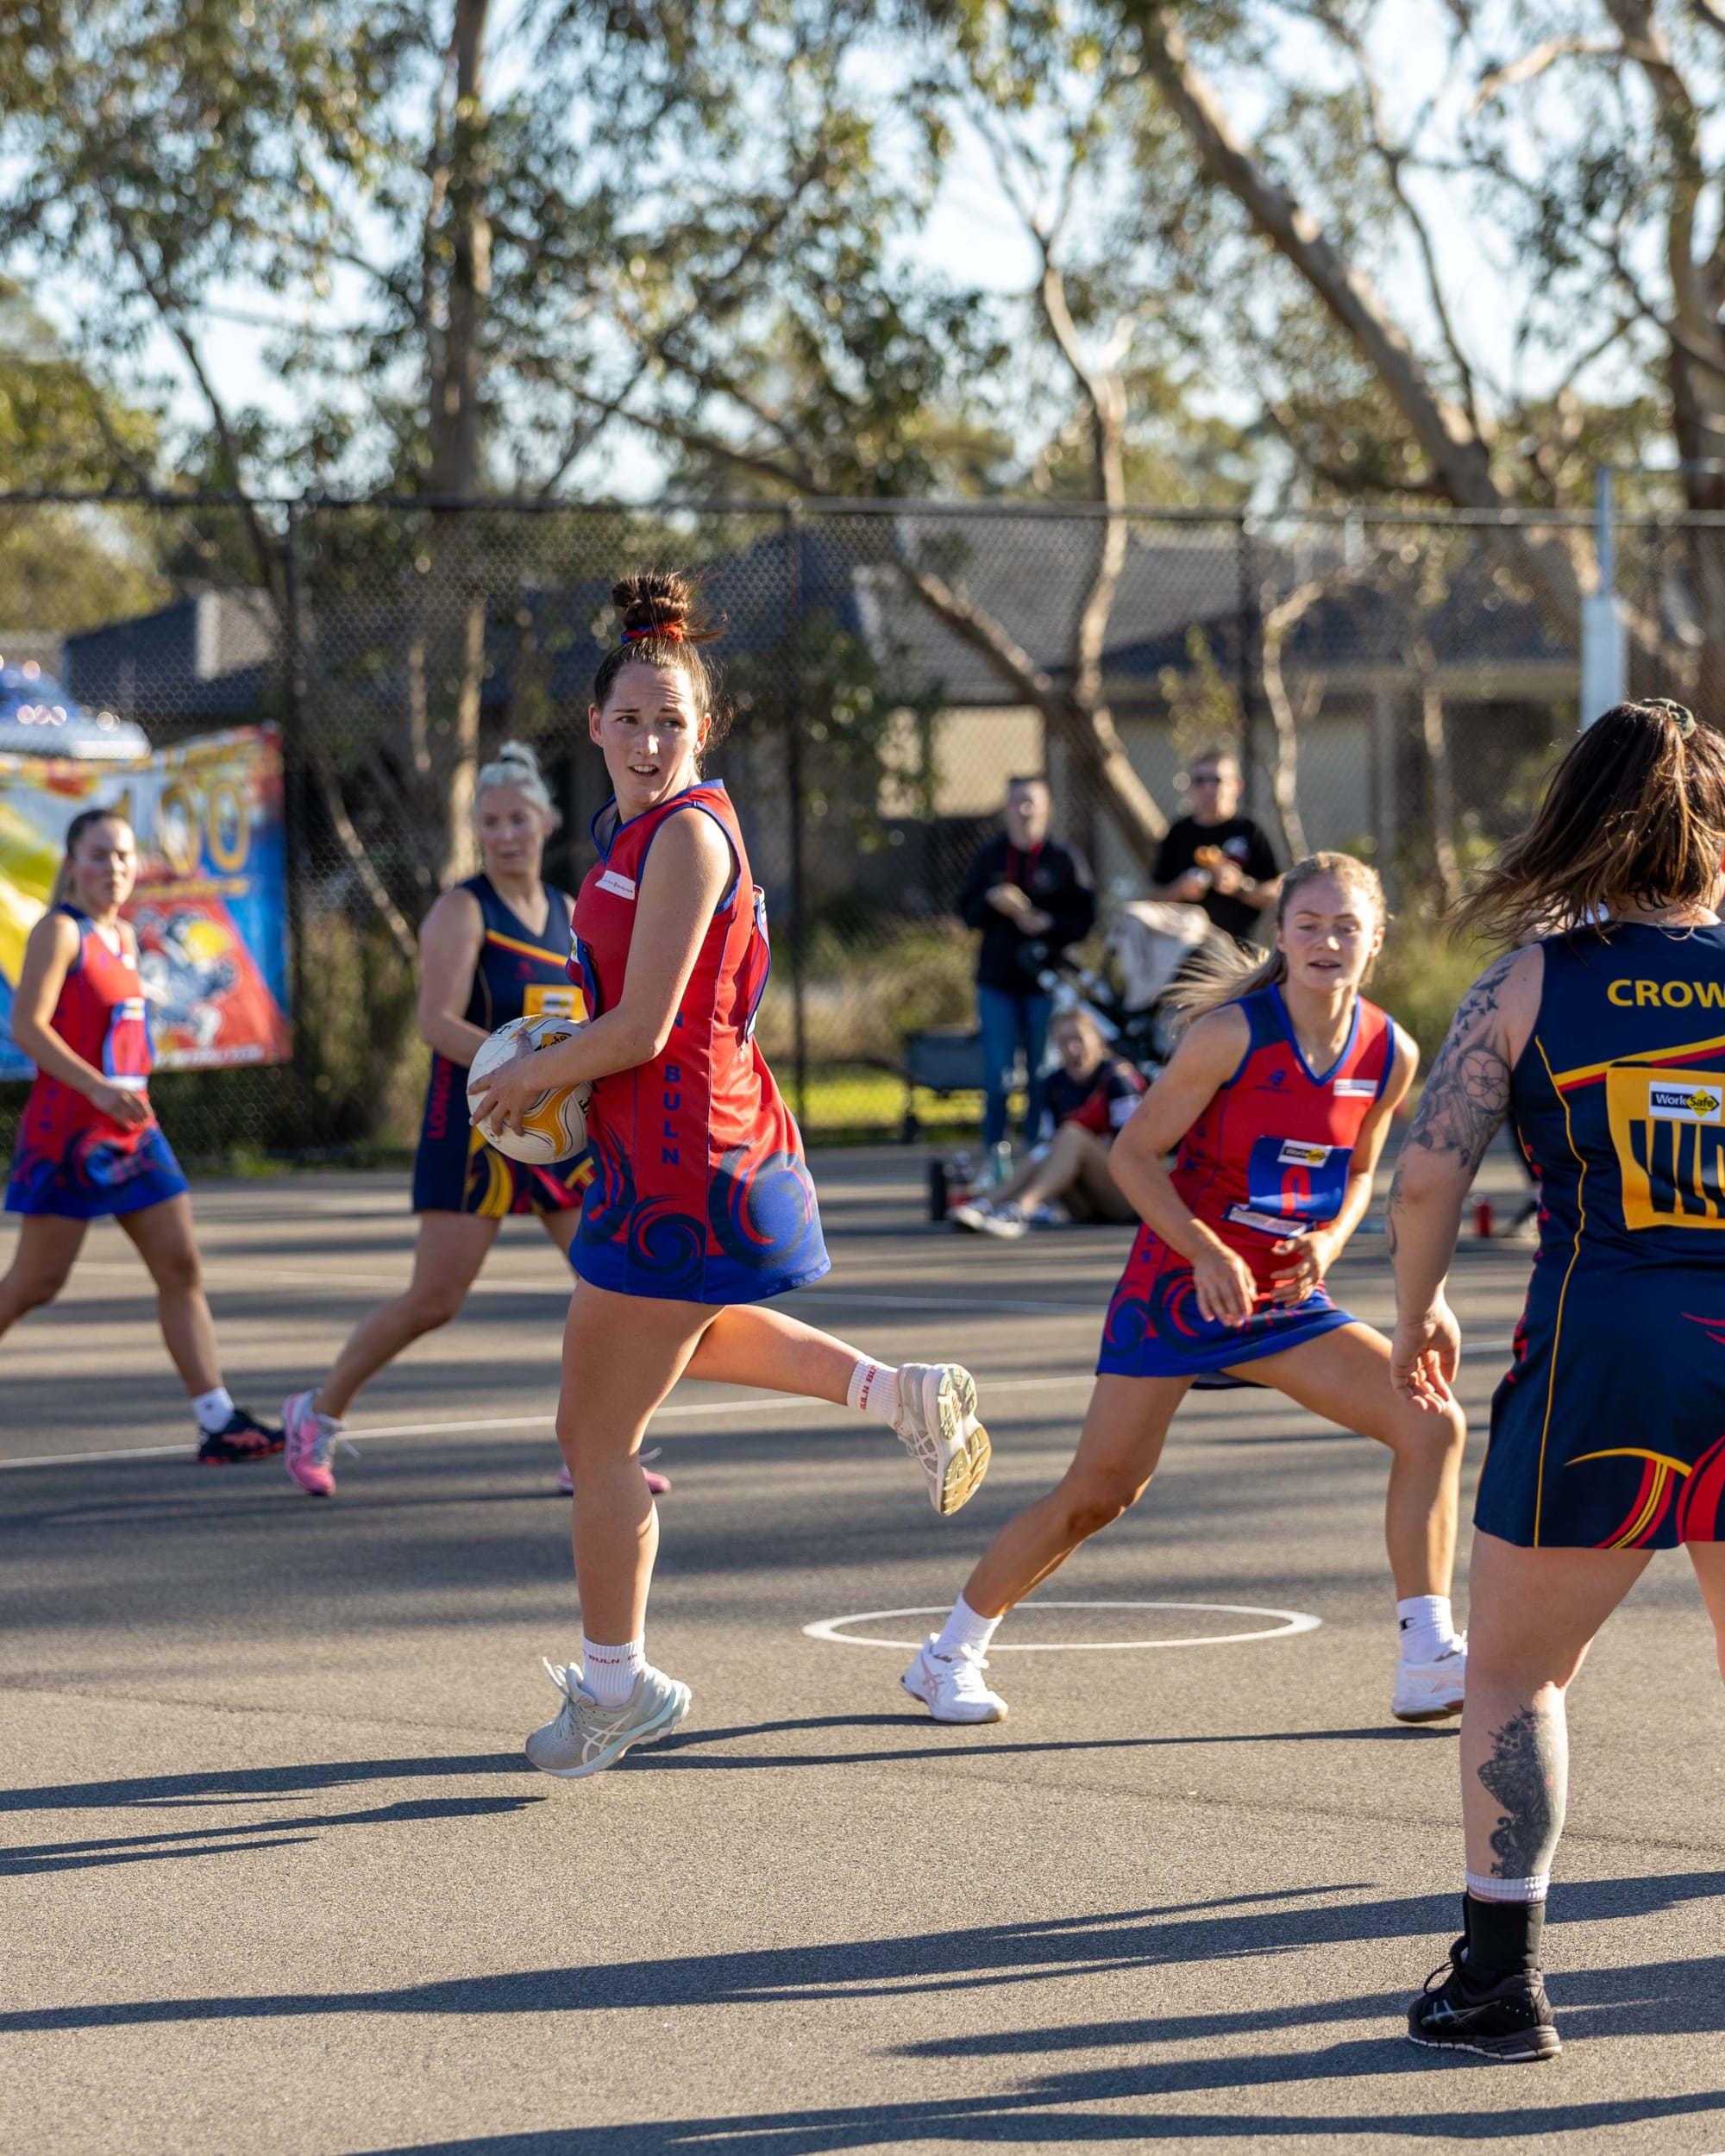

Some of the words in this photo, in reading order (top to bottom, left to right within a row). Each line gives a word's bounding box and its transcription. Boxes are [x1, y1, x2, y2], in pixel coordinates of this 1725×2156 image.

[116, 782, 250, 877] 00
[1607, 979, 1725, 1008] CROW
[662, 1064, 681, 1165] BULN
